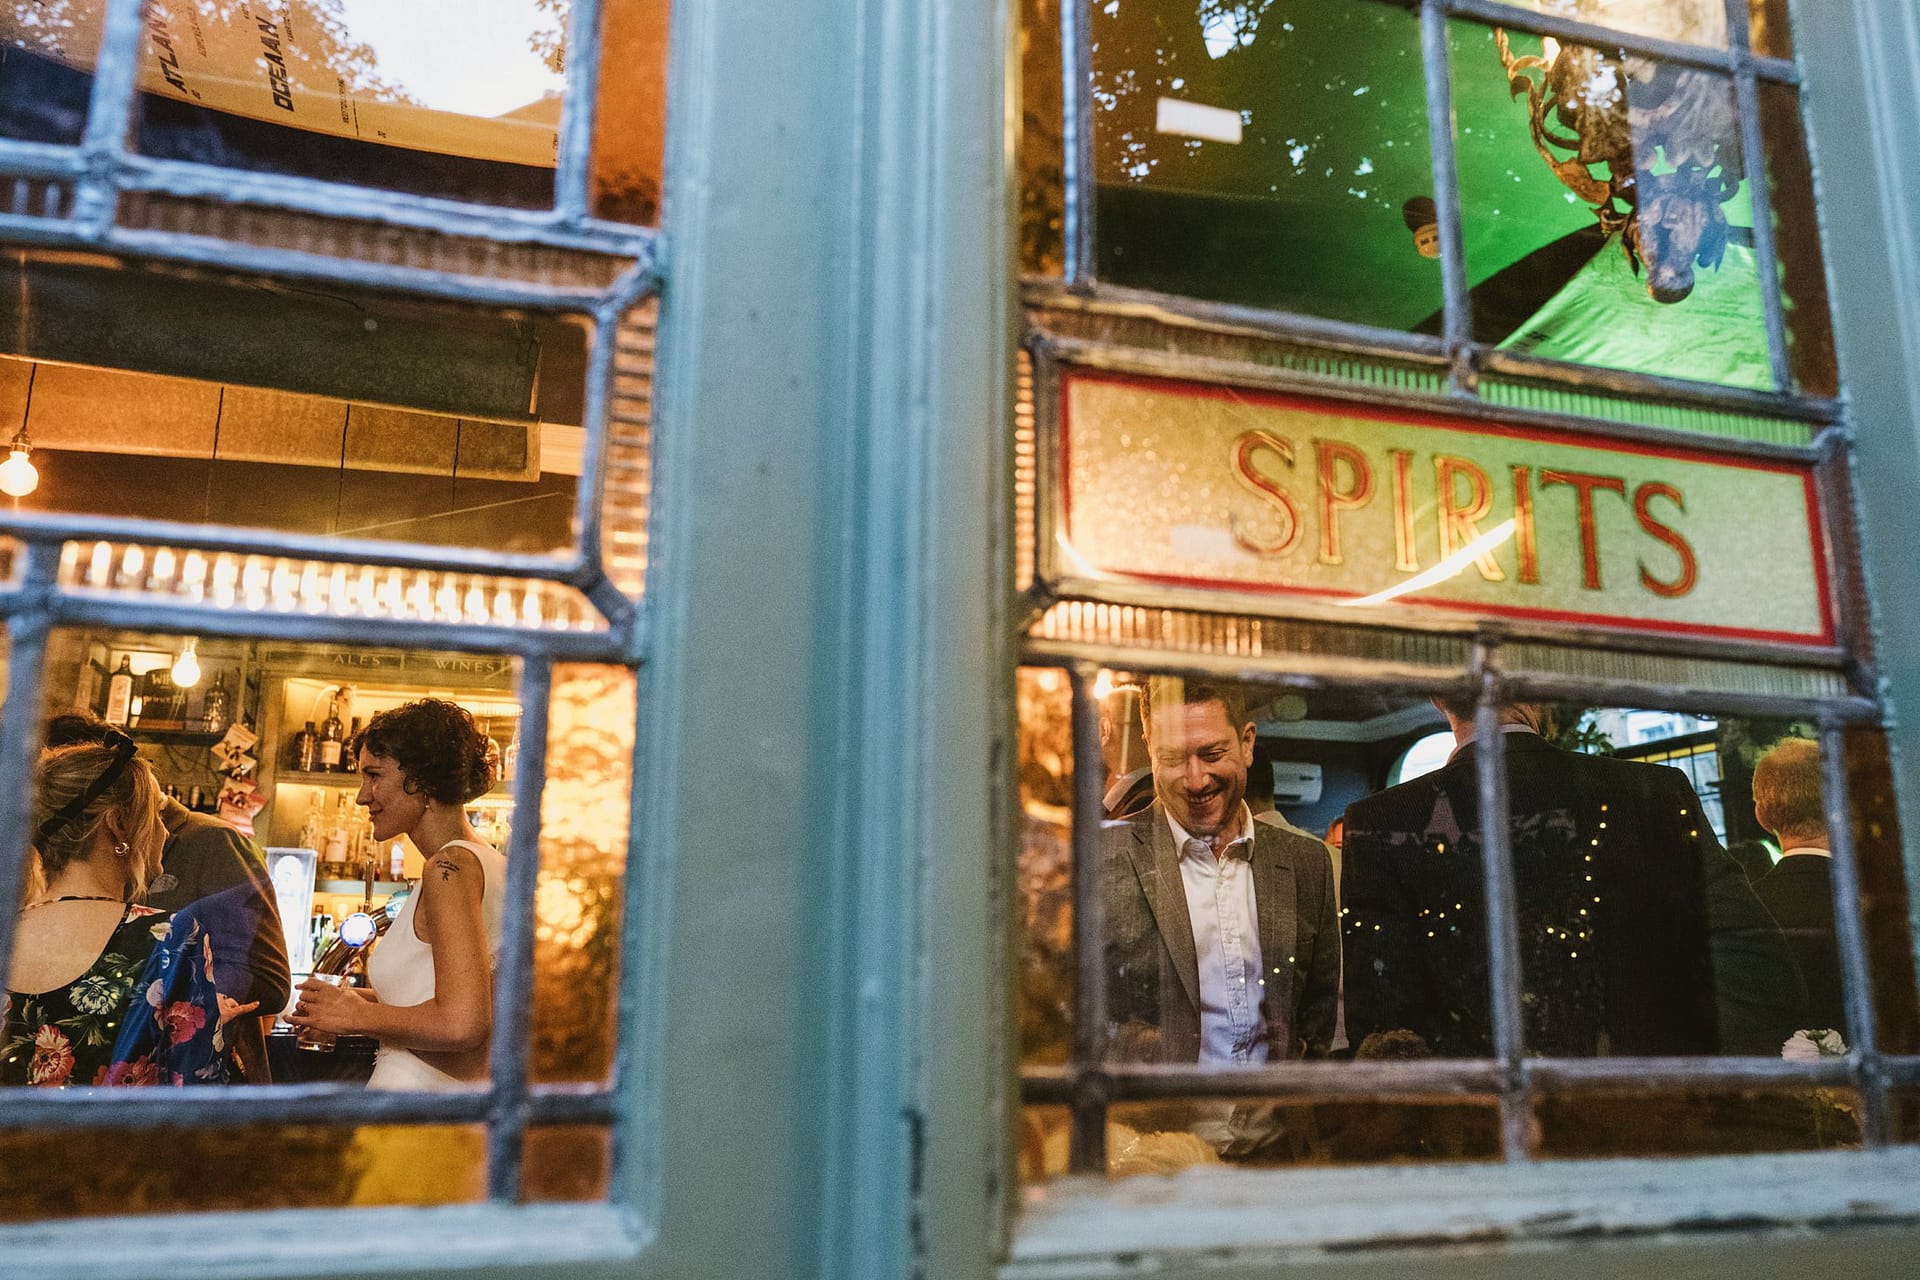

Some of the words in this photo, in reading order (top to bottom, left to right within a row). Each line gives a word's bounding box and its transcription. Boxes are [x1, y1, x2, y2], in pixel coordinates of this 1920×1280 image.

[255, 16, 294, 112] OCEAAN
[1230, 430, 1697, 598] SPIRITS
[334, 653, 382, 666] ALES
[434, 659, 496, 673] WINES
